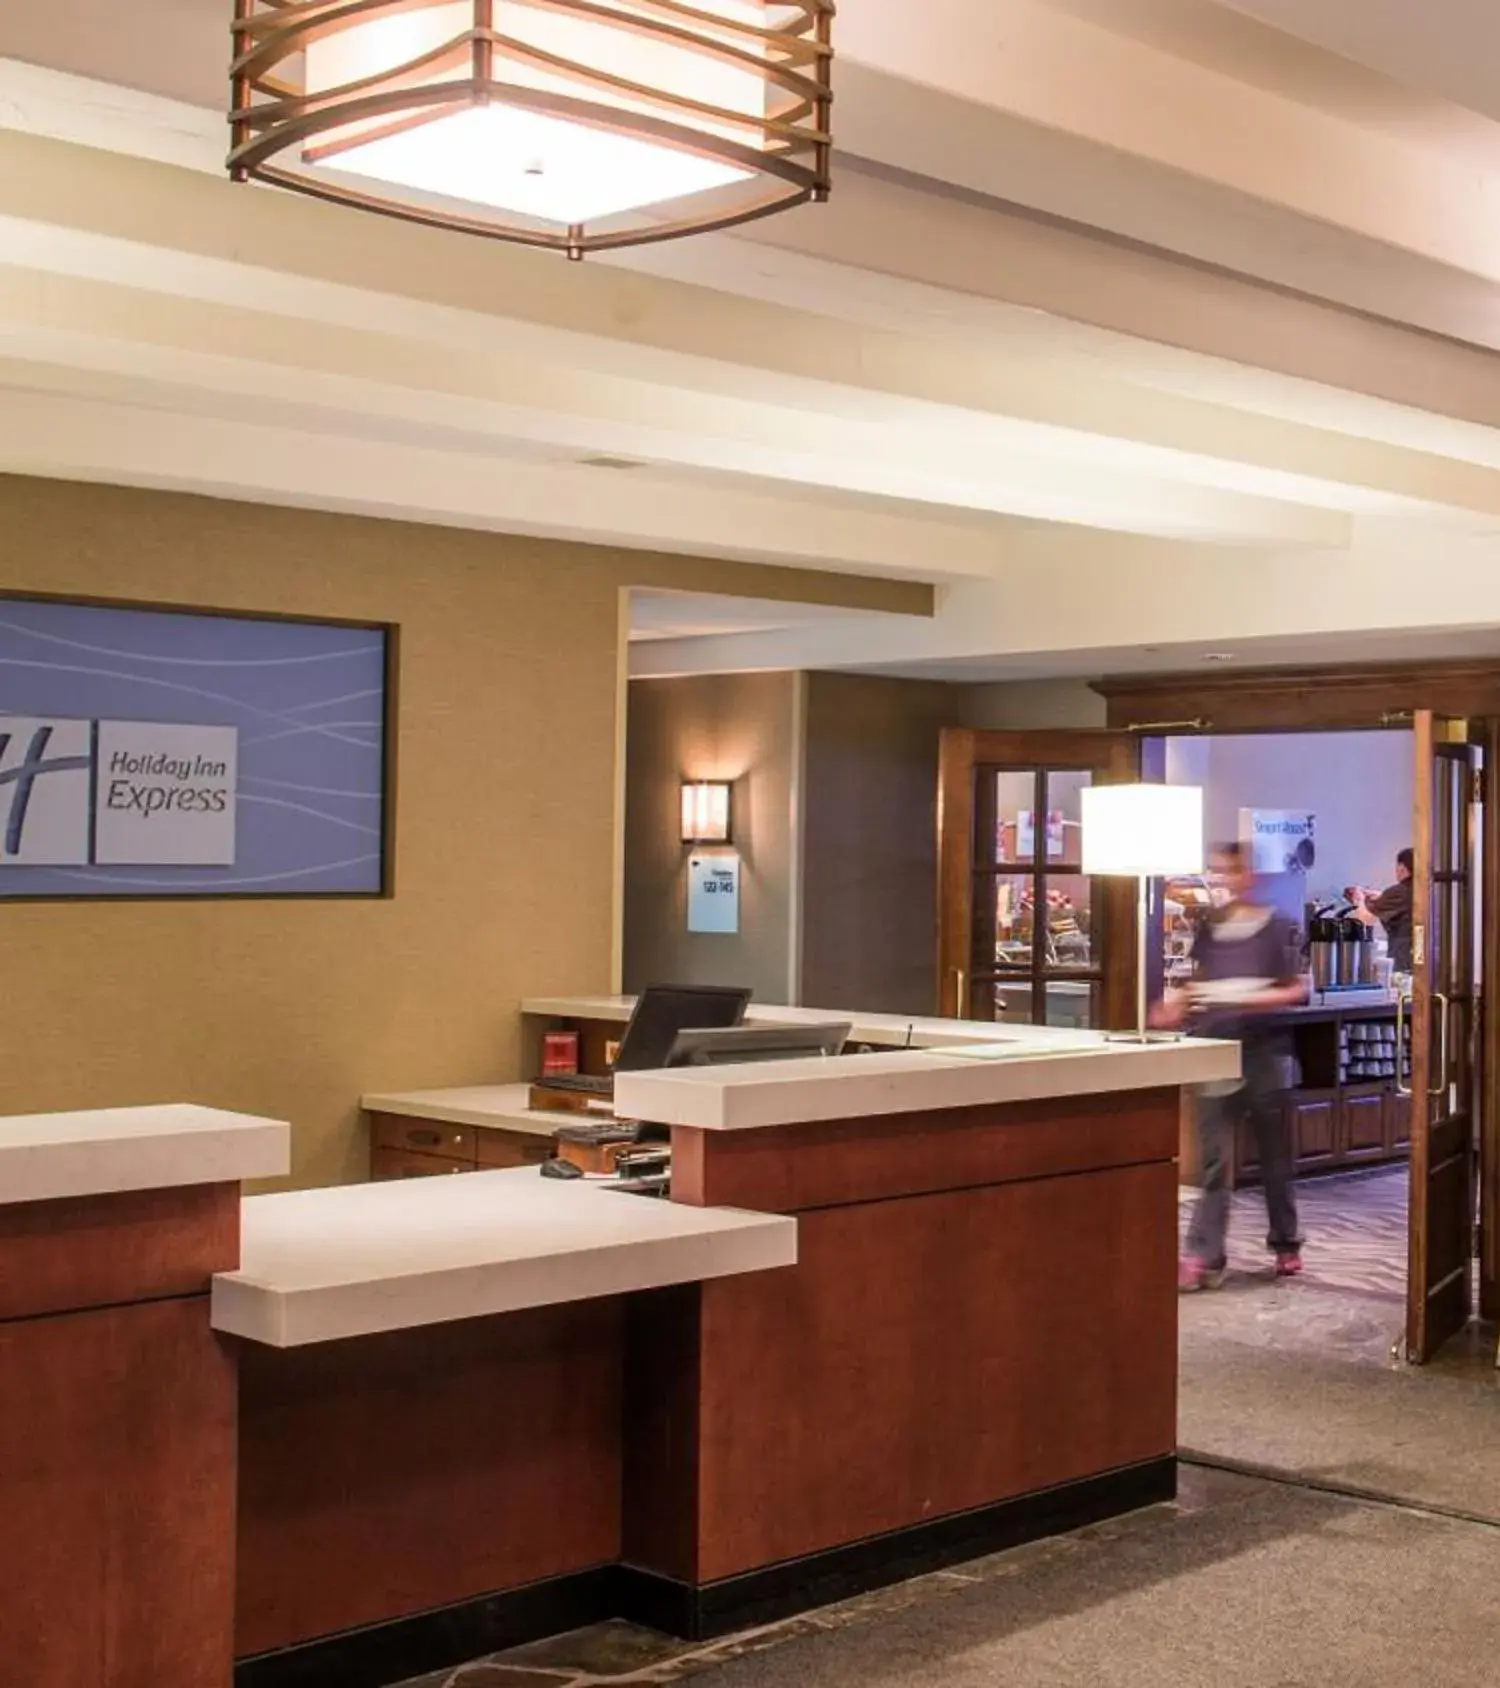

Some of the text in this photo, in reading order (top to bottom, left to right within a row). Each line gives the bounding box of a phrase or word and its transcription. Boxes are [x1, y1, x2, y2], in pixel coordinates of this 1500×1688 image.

[109, 751, 227, 781] Holiday Inn
[106, 780, 227, 817] Express
